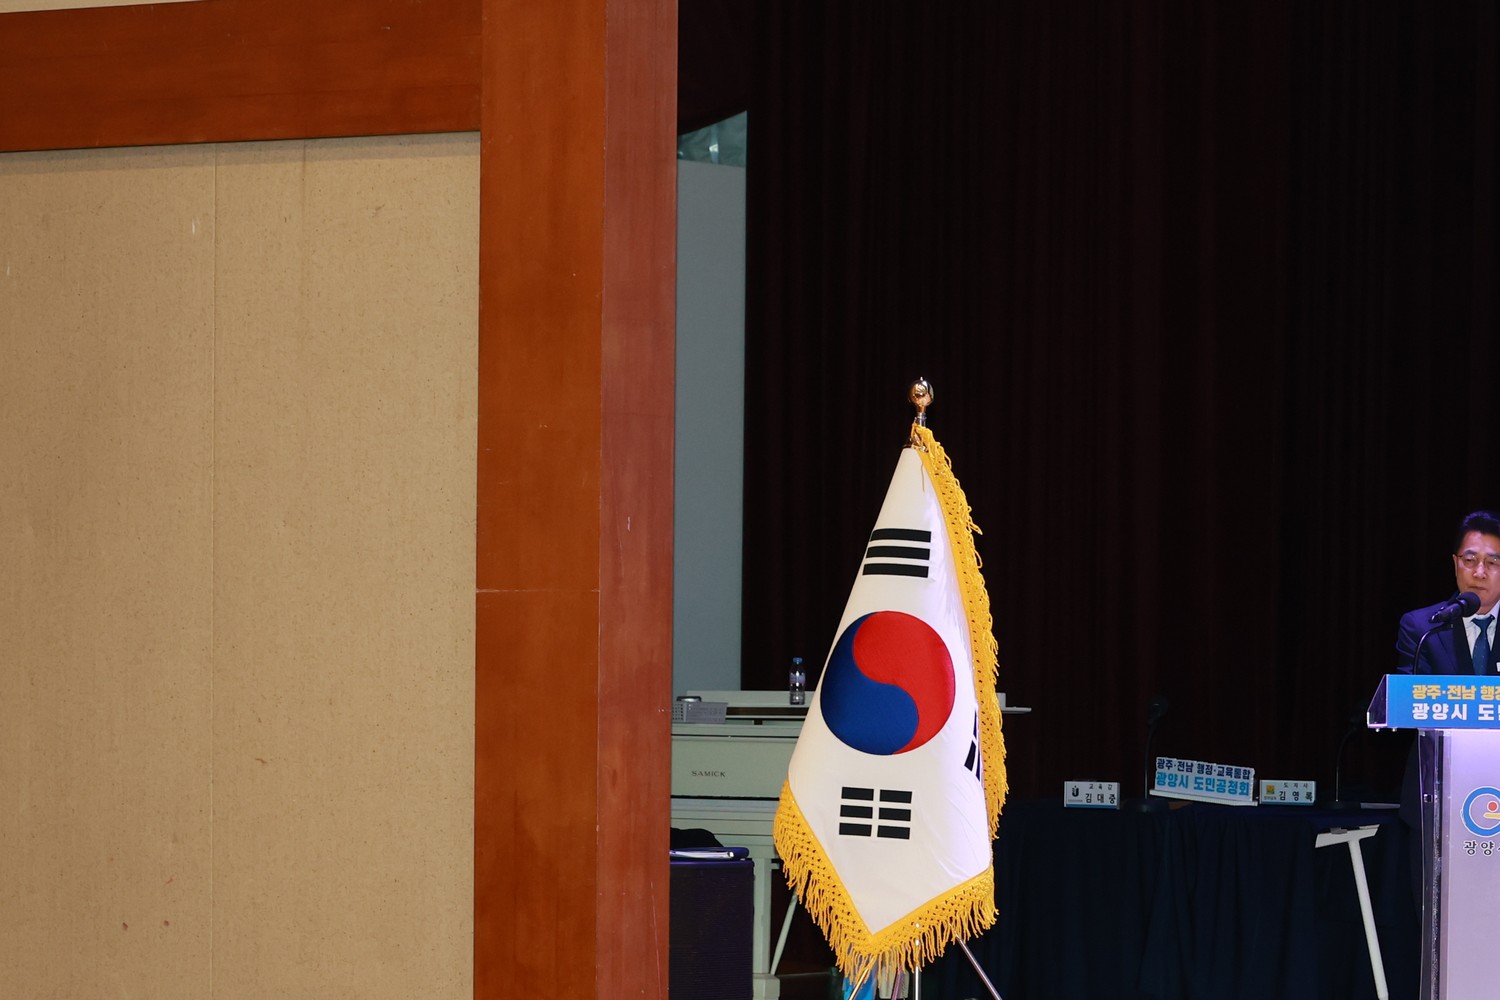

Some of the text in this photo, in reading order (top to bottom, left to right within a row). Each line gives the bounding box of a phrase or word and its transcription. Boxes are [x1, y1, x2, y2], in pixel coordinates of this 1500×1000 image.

[1412, 684, 1477, 700] 광주·전남
[1412, 702, 1468, 720] 광양시
[691, 770, 726, 778] SAMICK
[1156, 758, 1251, 780] 광주·전남 행정·교육통합
[1156, 771, 1250, 796] 광양시 도민공청회
